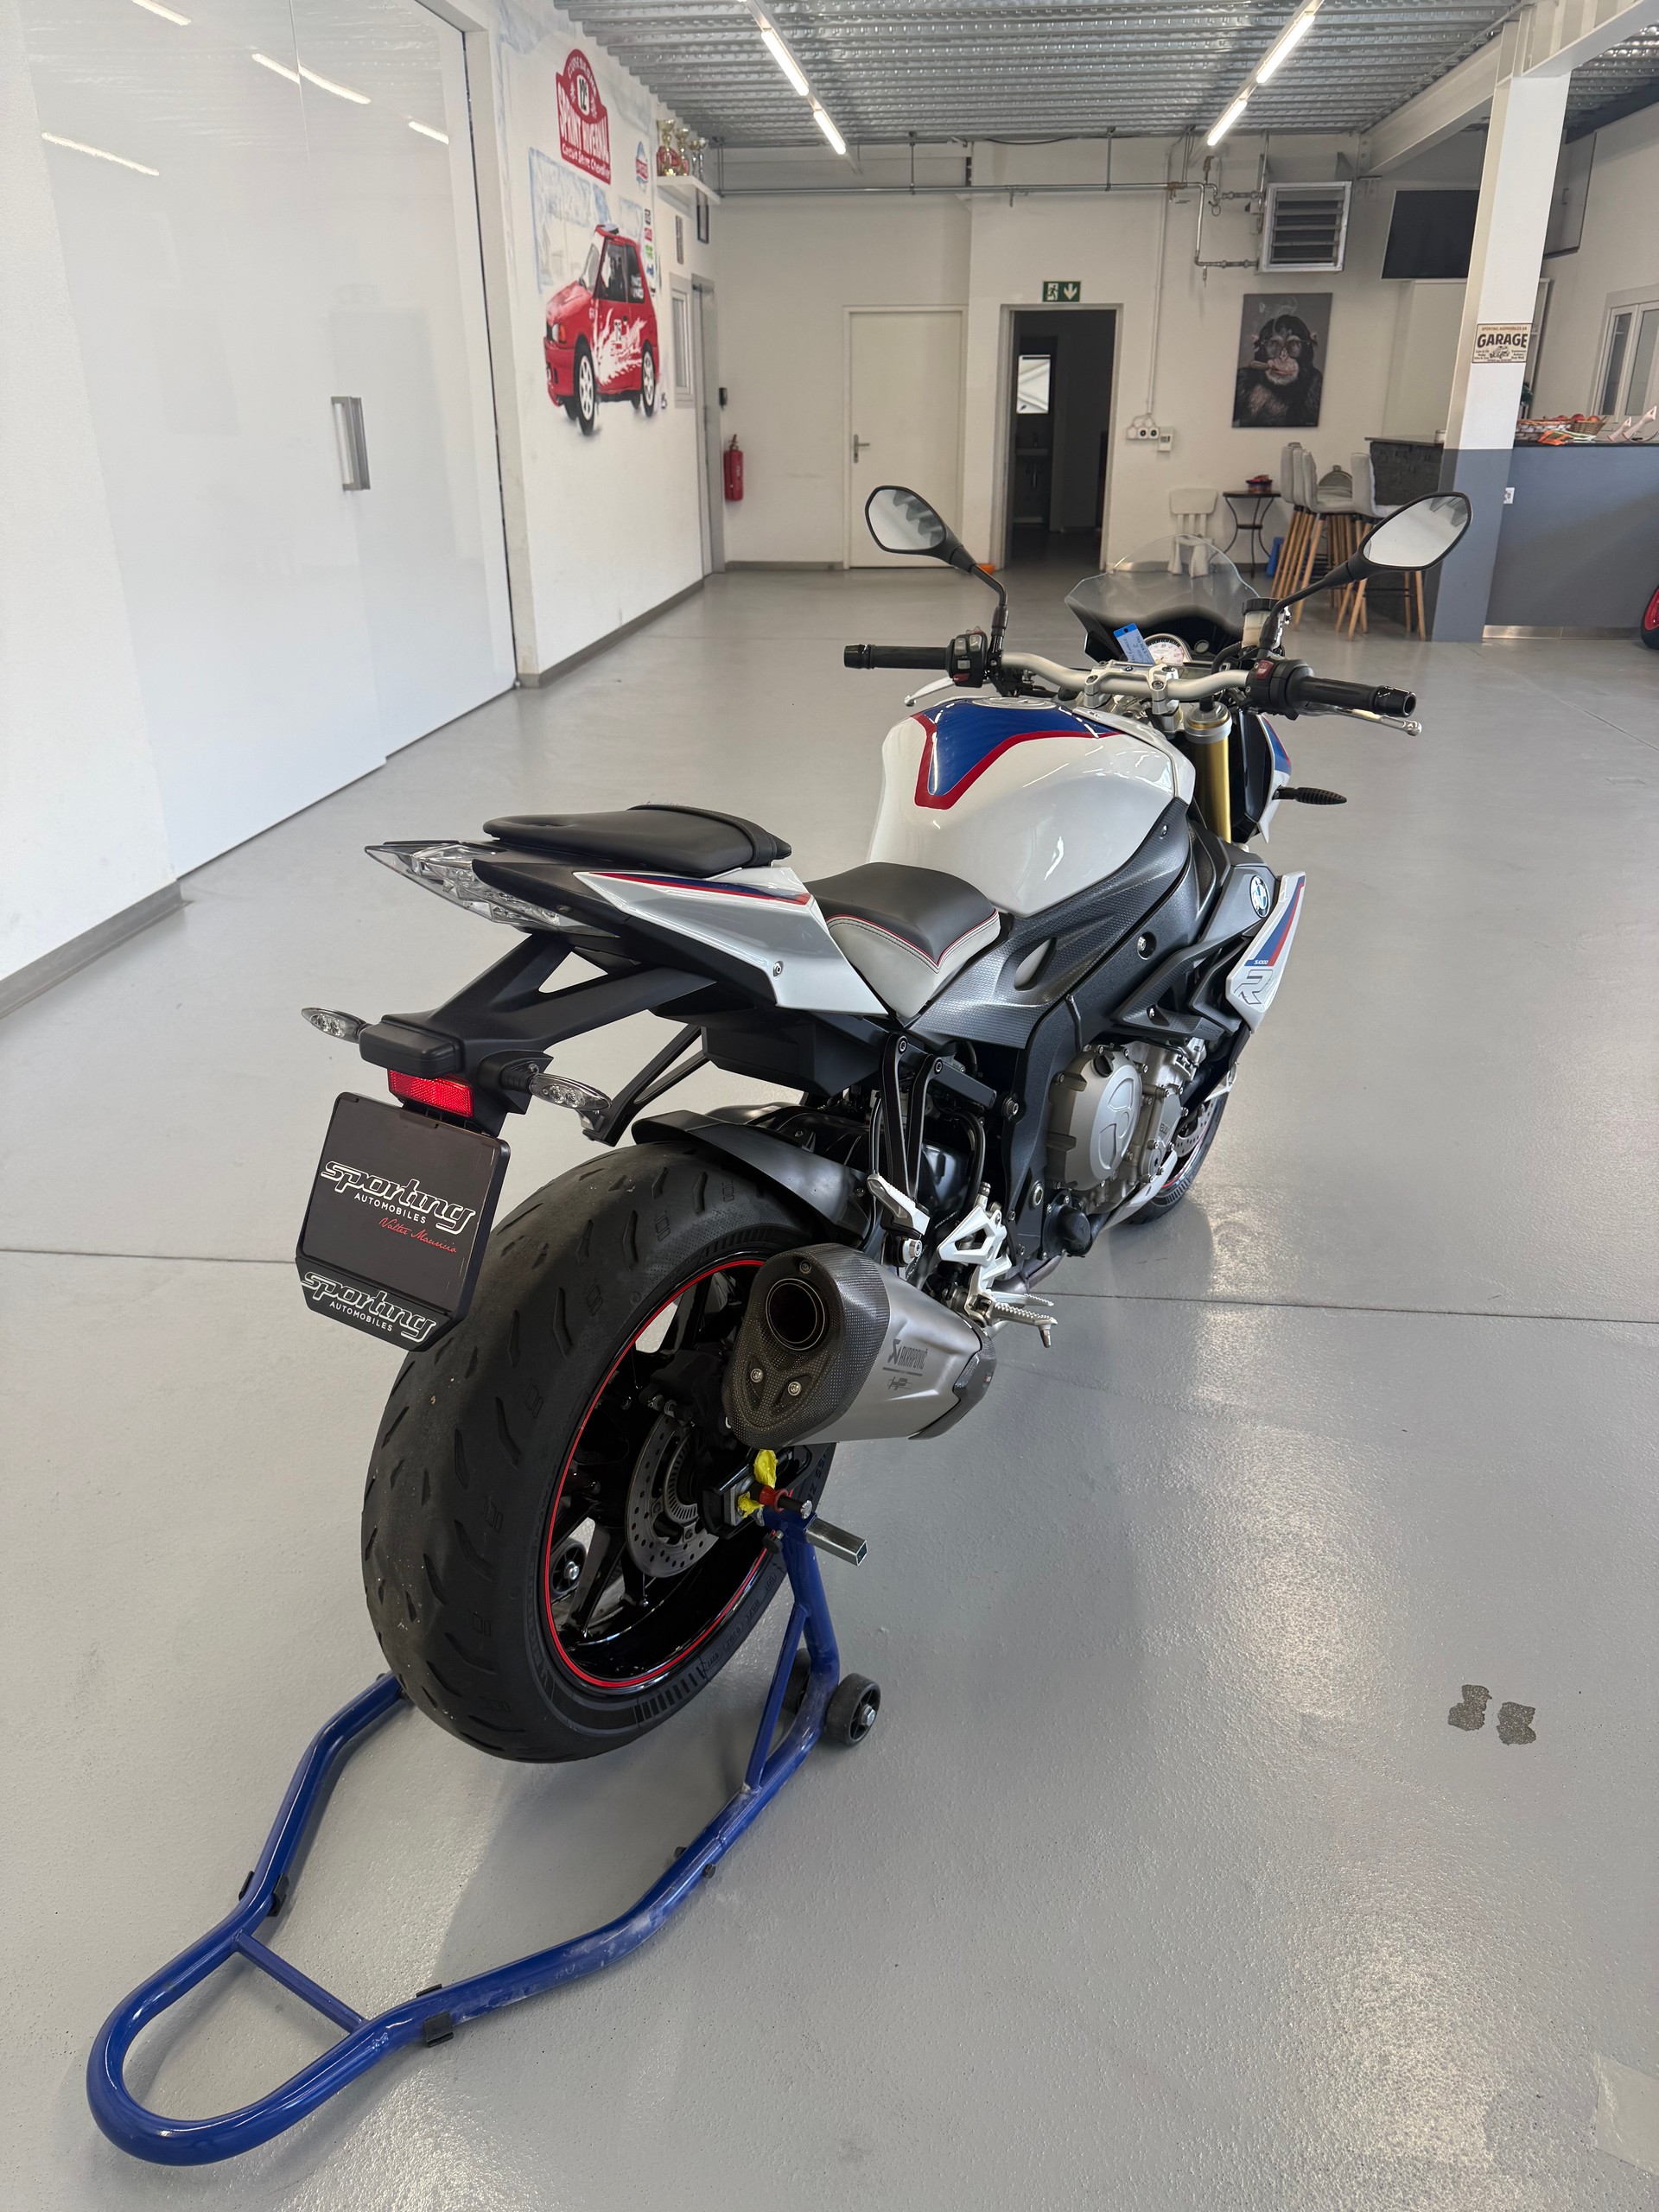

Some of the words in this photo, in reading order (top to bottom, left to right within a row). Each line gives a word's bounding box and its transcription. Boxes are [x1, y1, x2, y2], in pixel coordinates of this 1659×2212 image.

[1477, 334, 1529, 348] GARAGE
[353, 1192, 427, 1224] AUTOMOBILES
[328, 1301, 393, 1332] AUTOMOBILES
